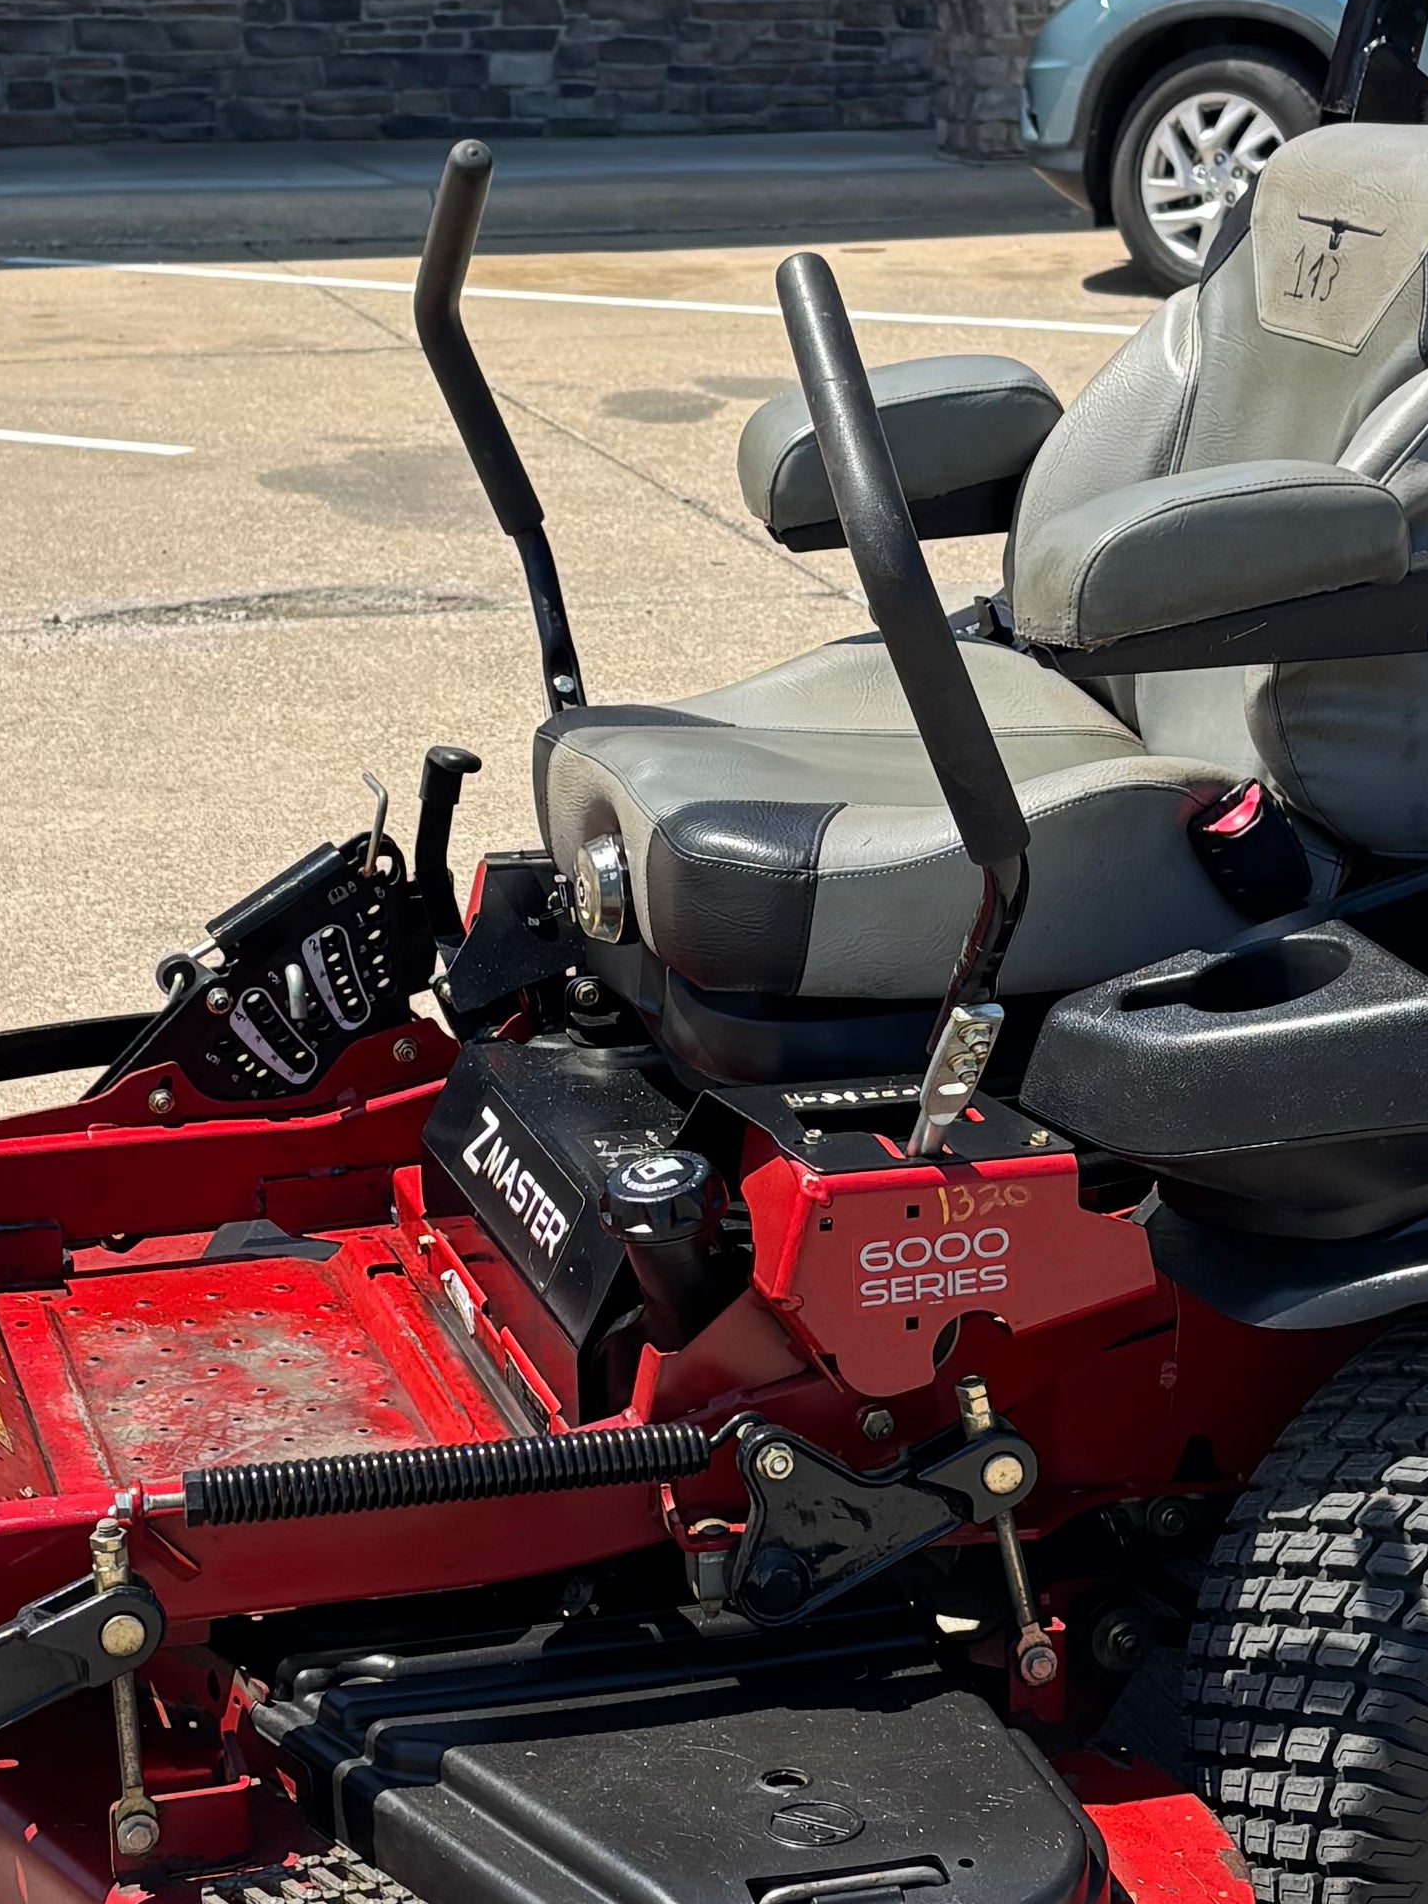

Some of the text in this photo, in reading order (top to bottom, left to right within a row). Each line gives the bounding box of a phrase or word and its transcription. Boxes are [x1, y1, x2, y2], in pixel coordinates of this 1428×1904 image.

[462, 1106, 567, 1259] Z MASTER
[859, 1227, 1010, 1273] 6000
[859, 1264, 1007, 1307] SERIES
